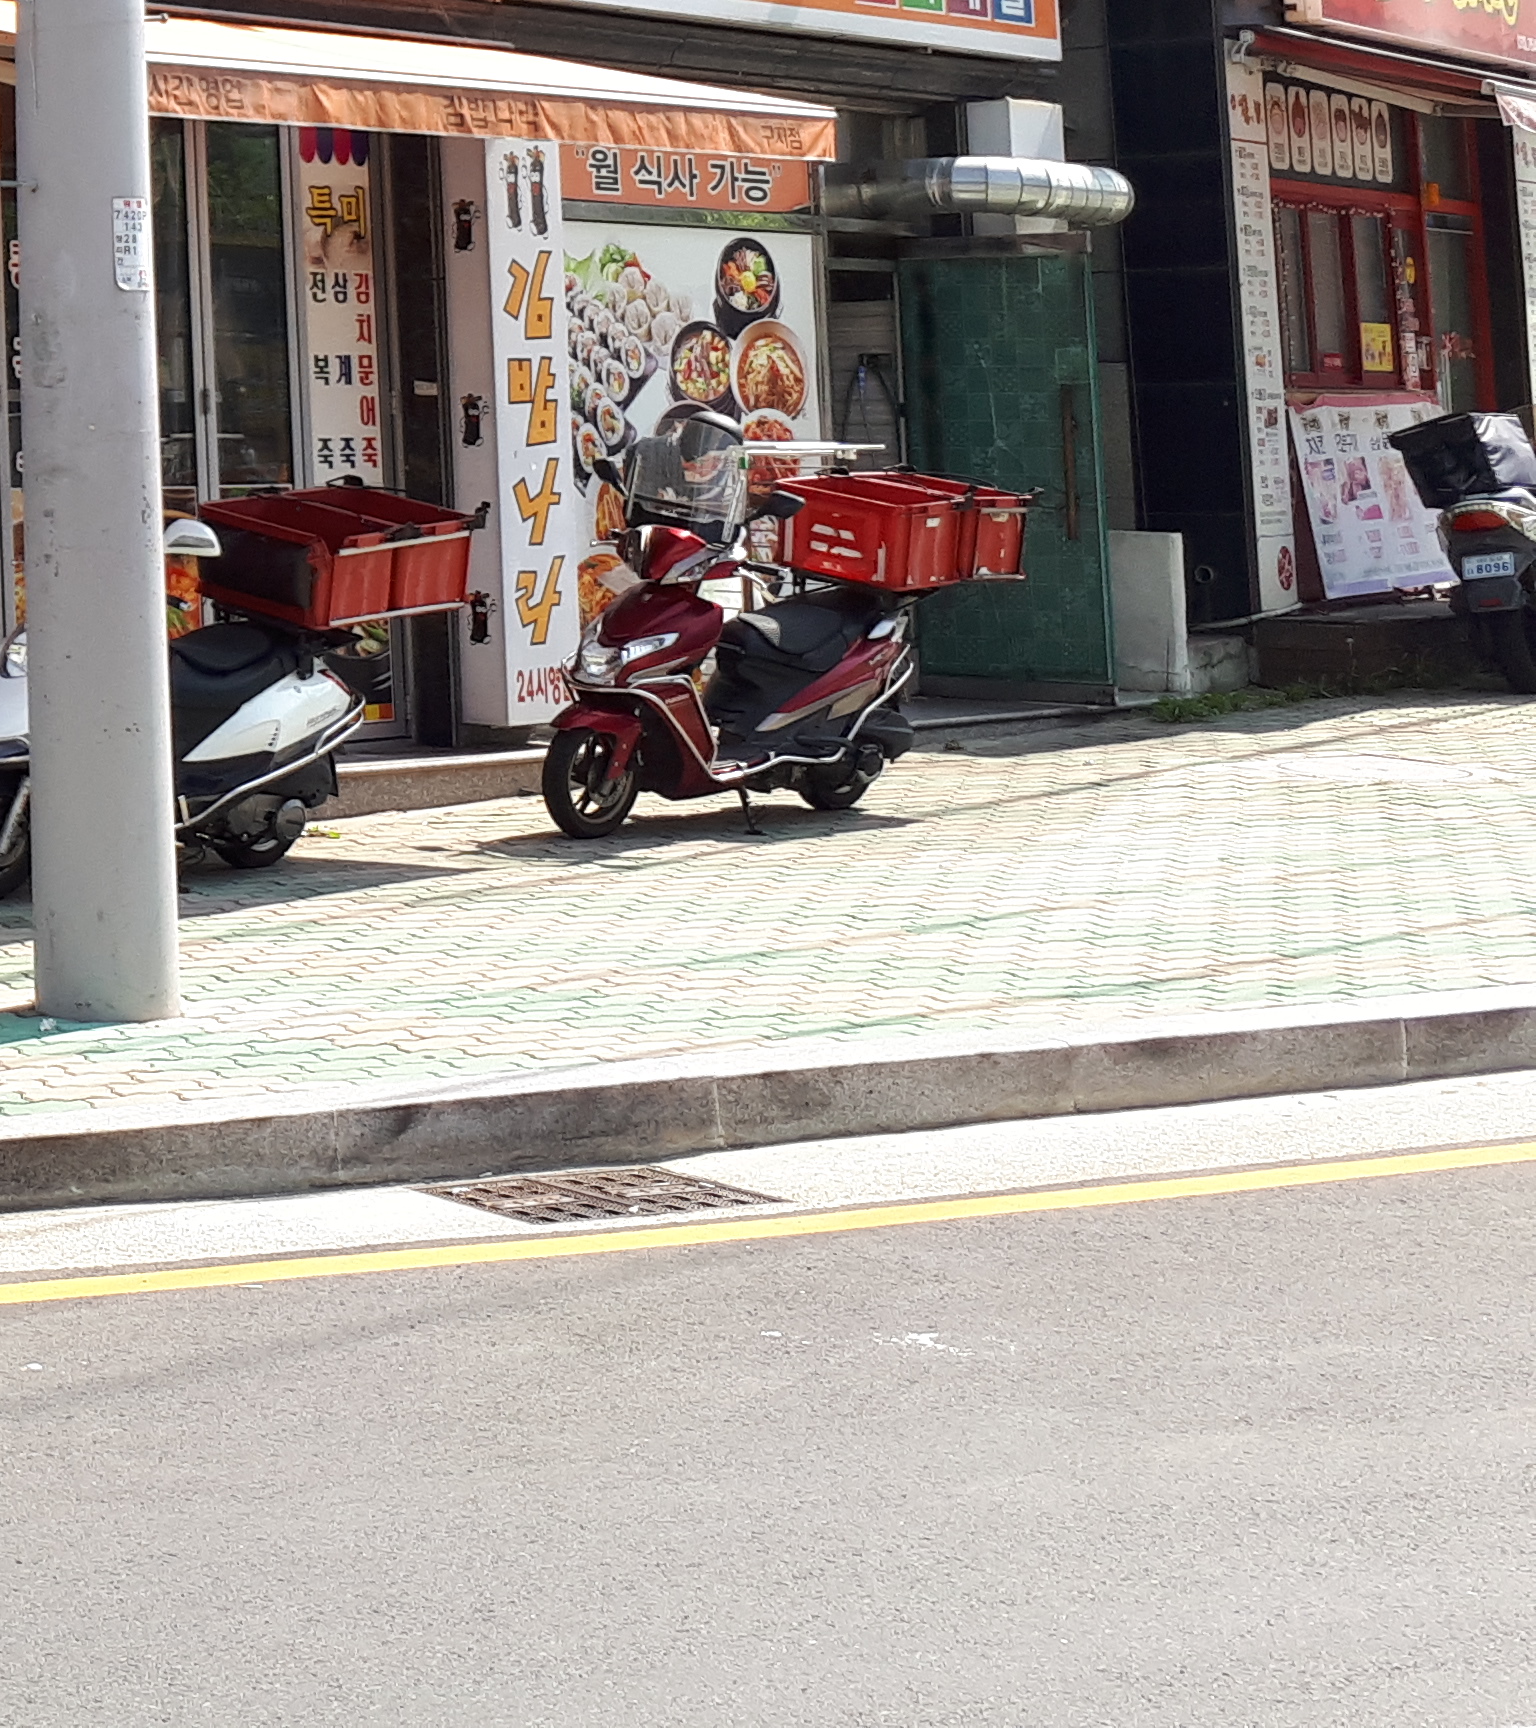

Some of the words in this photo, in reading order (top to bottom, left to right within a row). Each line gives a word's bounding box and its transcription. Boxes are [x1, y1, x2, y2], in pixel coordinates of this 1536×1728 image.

[632, 152, 701, 200] 식사
[306, 185, 367, 239] 특미
[516, 666, 572, 706] 24시영
